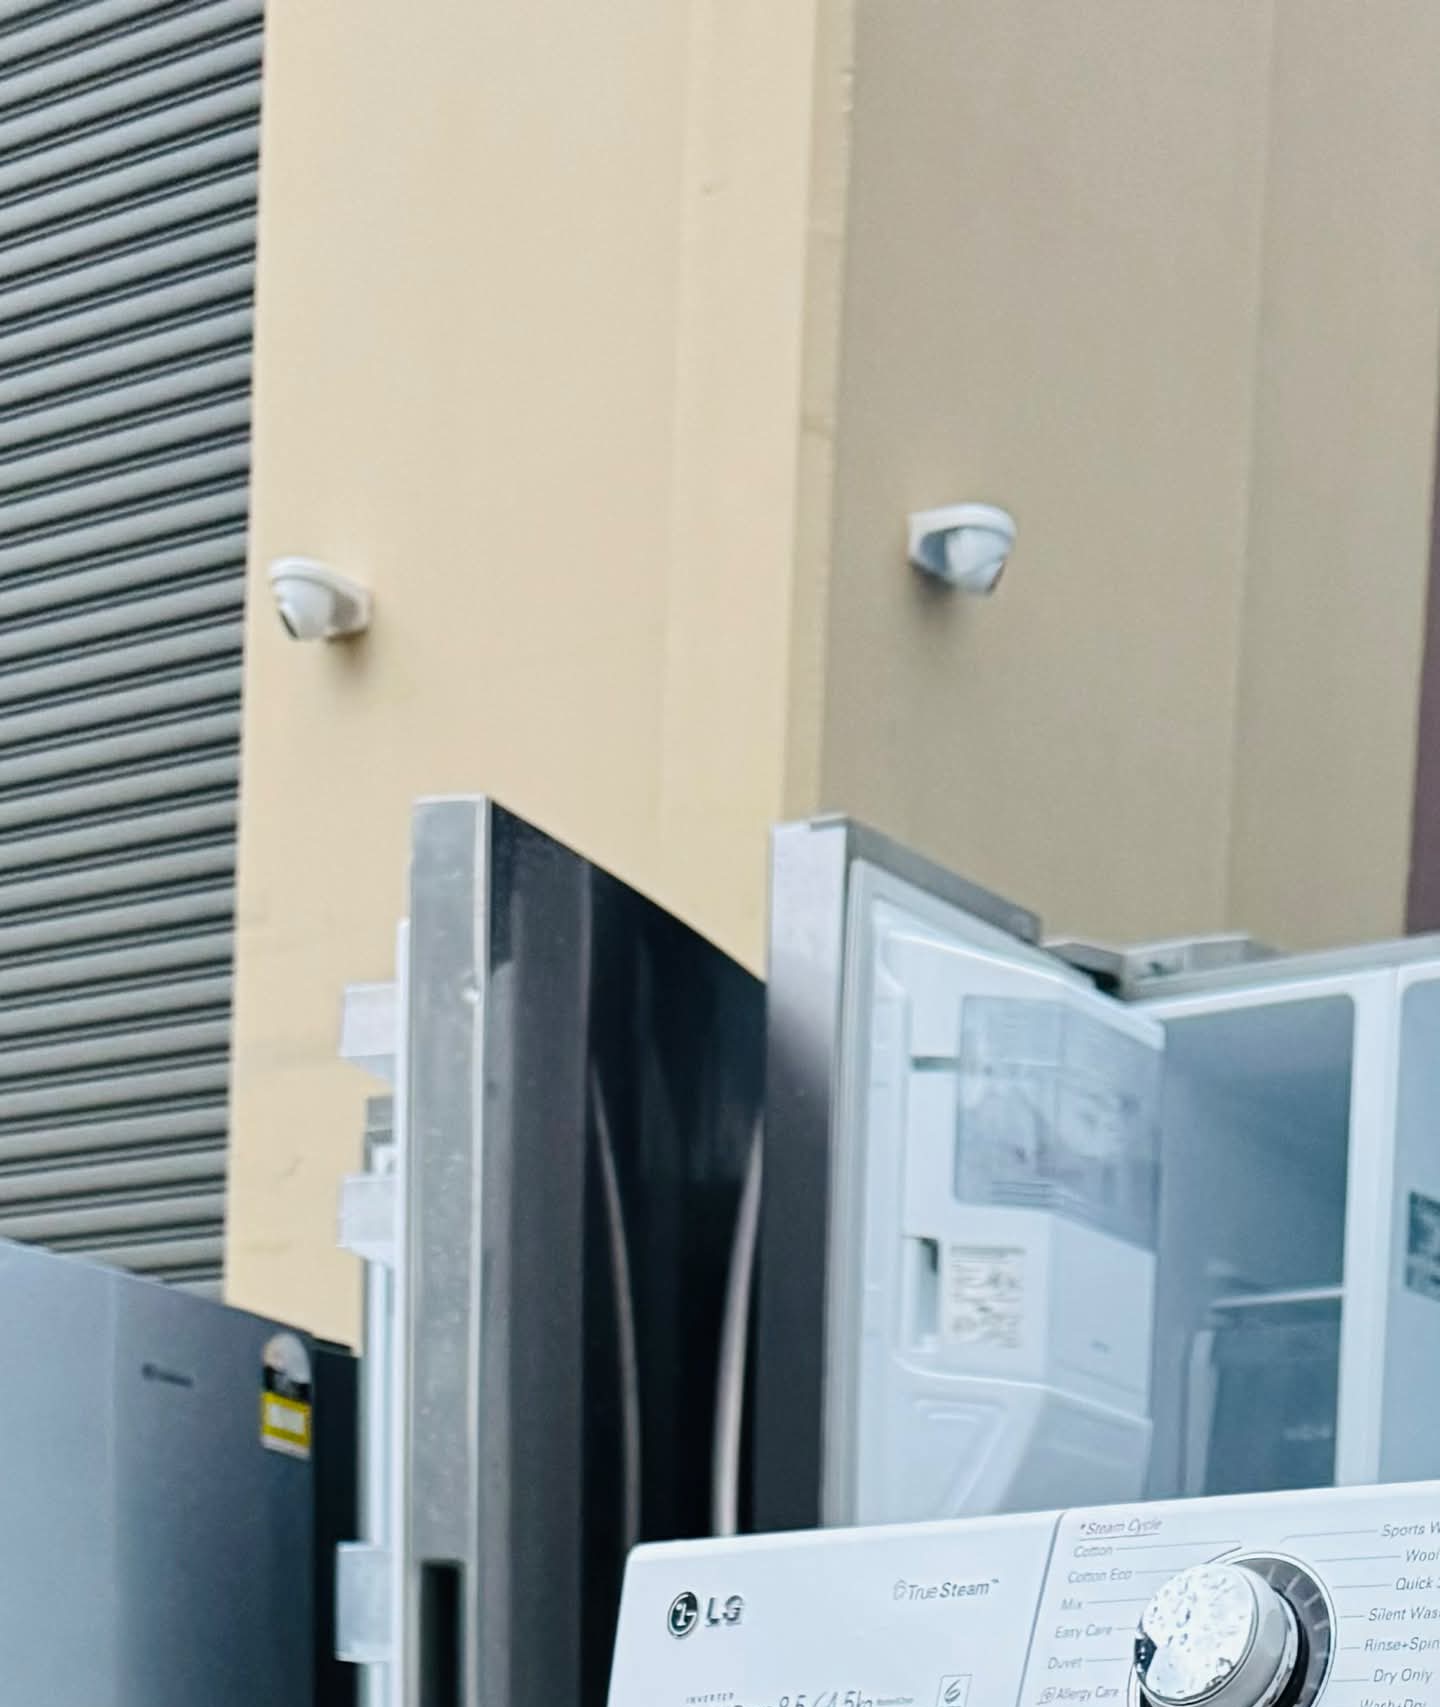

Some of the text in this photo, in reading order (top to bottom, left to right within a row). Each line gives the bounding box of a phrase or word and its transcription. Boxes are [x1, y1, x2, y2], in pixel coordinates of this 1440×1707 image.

[1381, 1523, 1425, 1539] Sports
[1073, 1545, 1113, 1558] Cotton
[1405, 1548, 1440, 1562] Wool
[1067, 1567, 1133, 1584] Cotton Eco
[1395, 1576, 1433, 1591] Quick
[704, 1594, 746, 1626] LG
[1368, 1607, 1407, 1621] Silent
[1086, 1623, 1113, 1637] Care
[1373, 1667, 1434, 1685] Dry Only
